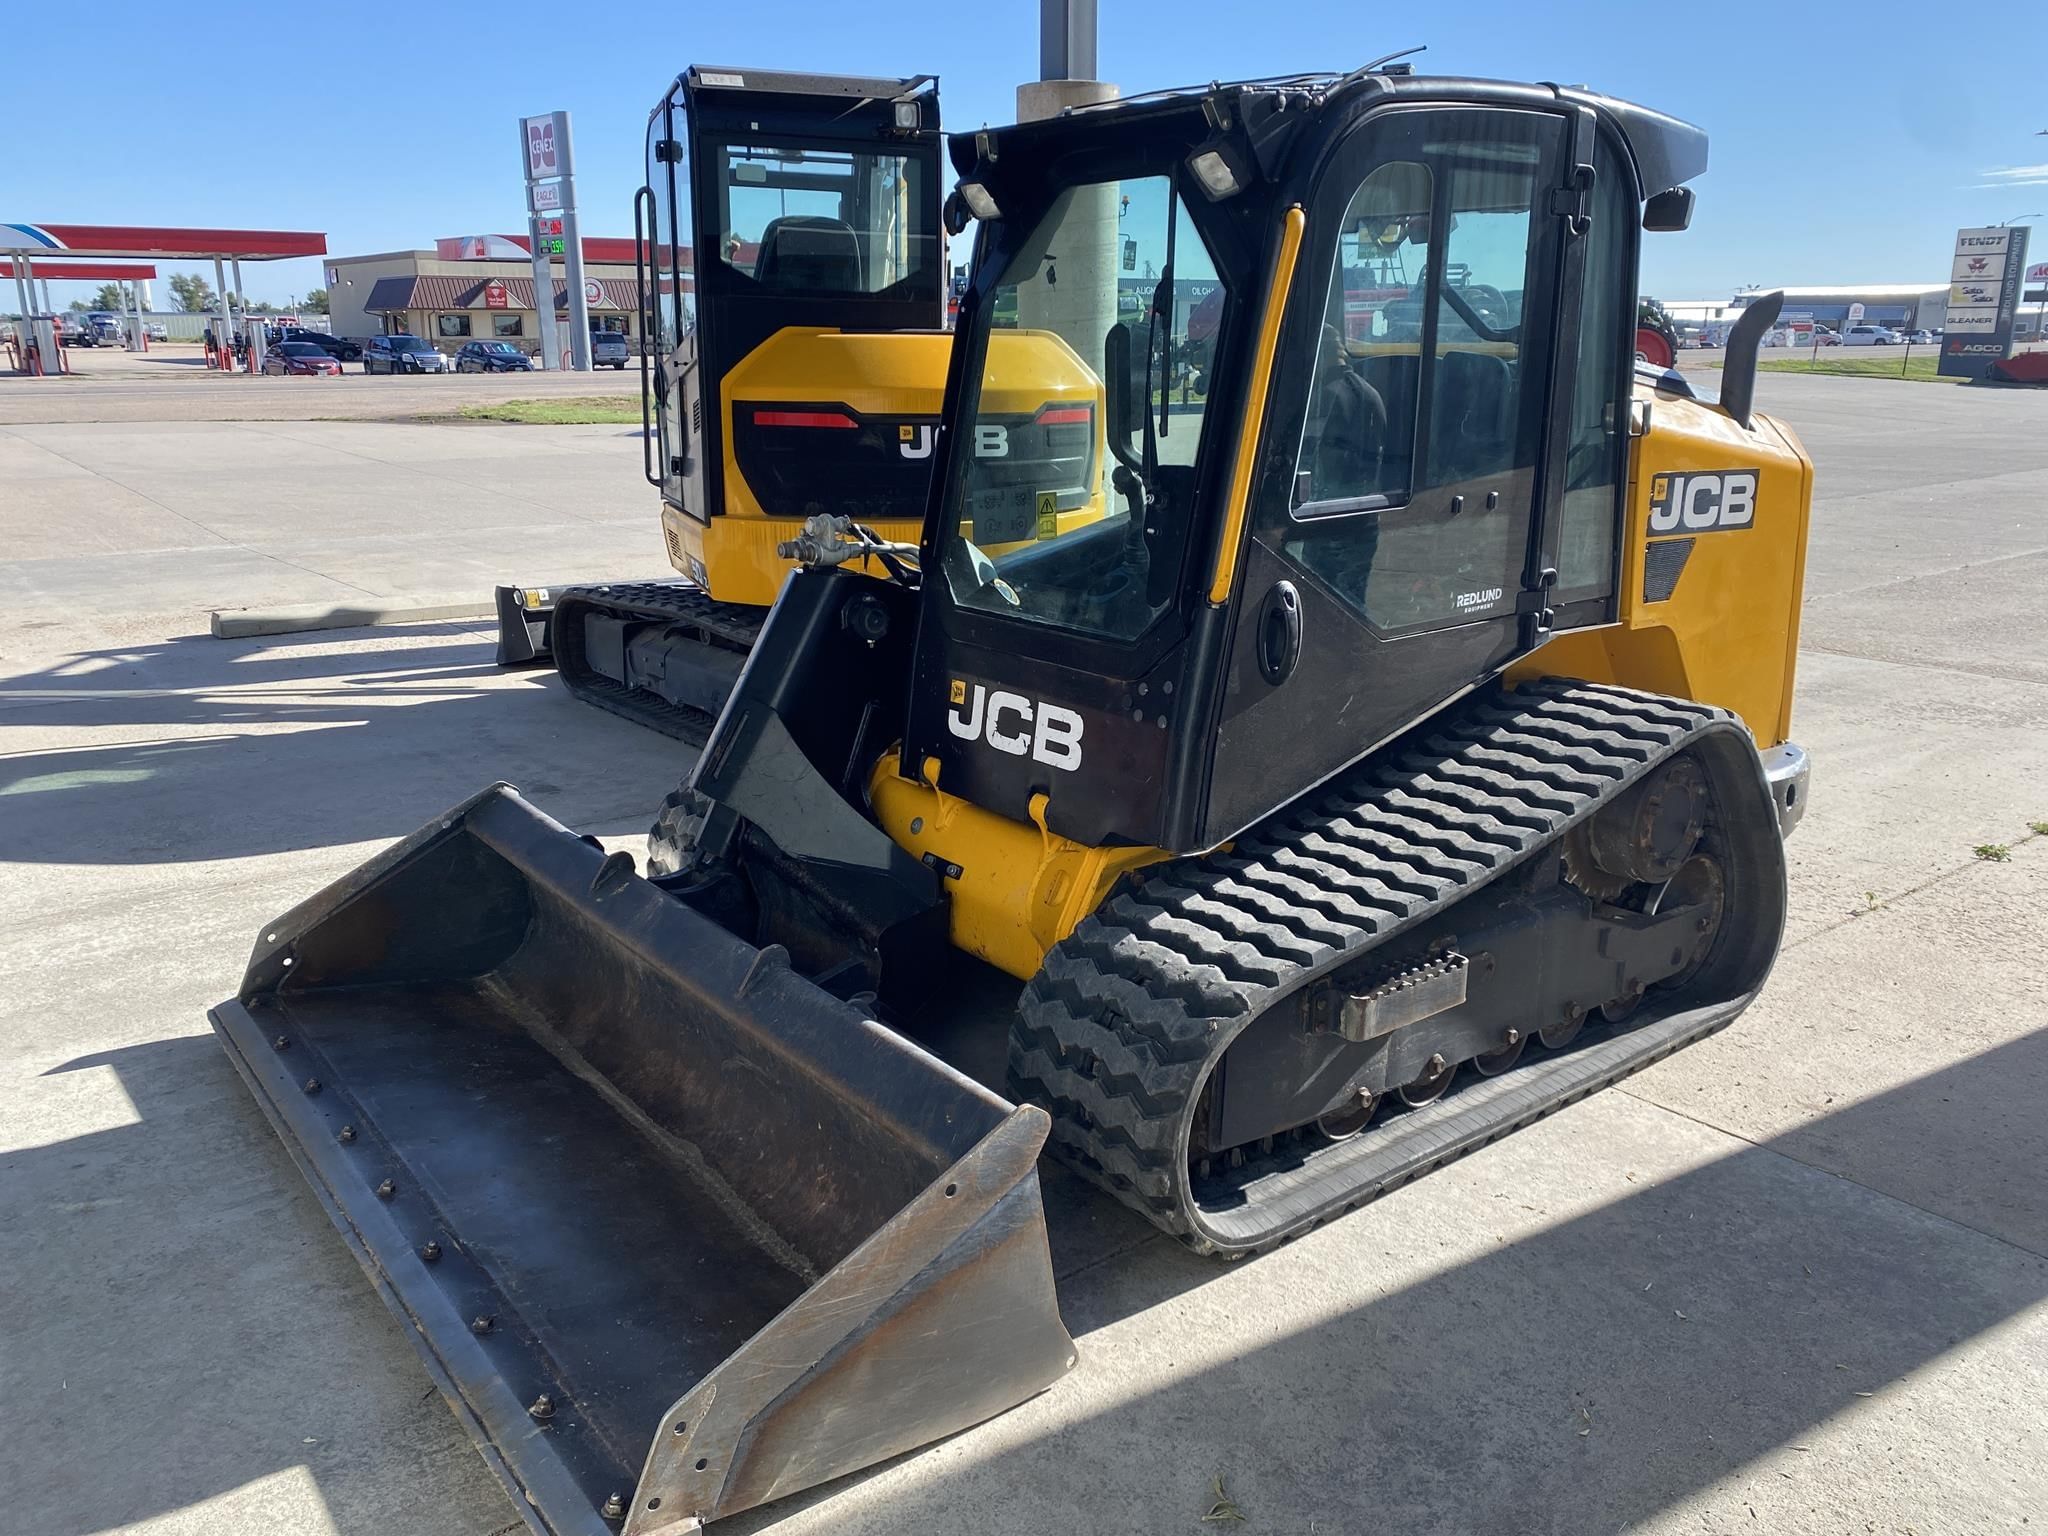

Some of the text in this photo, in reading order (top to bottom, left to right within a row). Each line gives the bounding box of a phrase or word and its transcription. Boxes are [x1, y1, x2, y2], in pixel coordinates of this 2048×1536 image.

[532, 137, 554, 154] CENEX
[1960, 236, 2006, 246] FENDT
[2007, 232, 2024, 278] EQUIPMENT
[1963, 344, 2004, 353] AGCO
[900, 425, 1009, 459] JB
[1650, 474, 1756, 531] JCB
[1456, 588, 1503, 608] REDLUND
[1464, 602, 1494, 614] EQUIPMENT
[948, 684, 1084, 772] JCB
